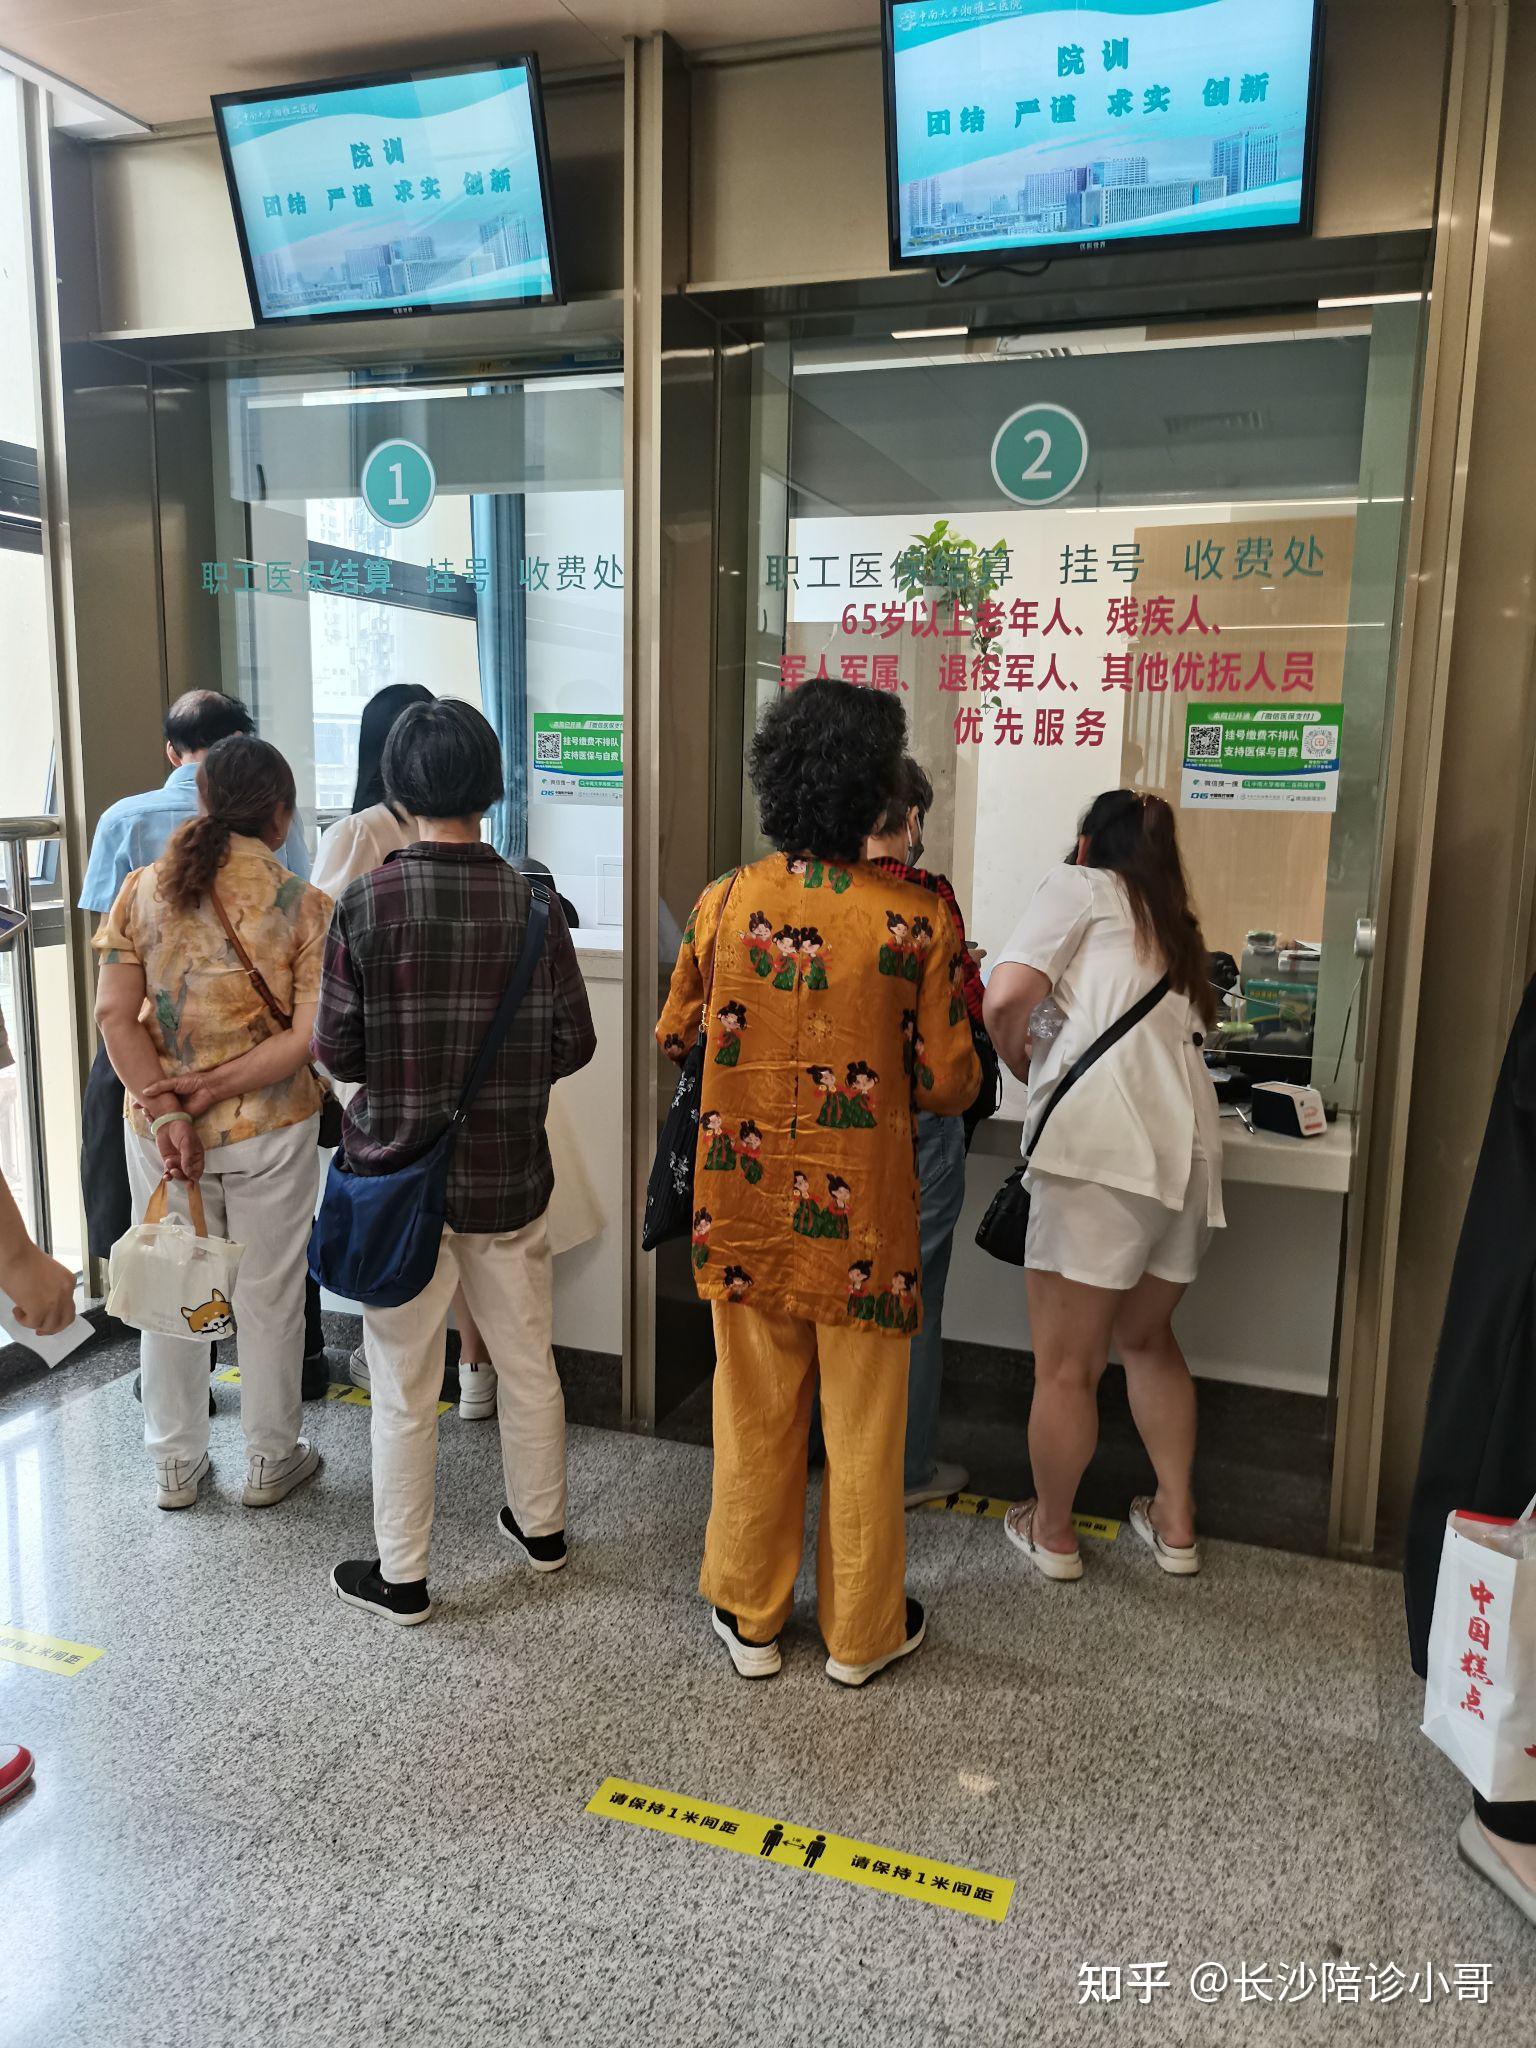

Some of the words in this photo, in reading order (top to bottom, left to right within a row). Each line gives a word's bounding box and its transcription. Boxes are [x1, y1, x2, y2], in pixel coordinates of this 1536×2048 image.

[1056, 37, 1129, 77] 院训
[926, 105, 986, 137] 团结
[1014, 94, 1077, 128] 严谨
[1107, 84, 1172, 117] 求实
[1202, 72, 1270, 106] 创新
[350, 137, 405, 169] 院训
[263, 192, 307, 217] 团结
[327, 184, 373, 211] 严谨
[393, 176, 442, 203] 求实
[463, 167, 512, 196] 创新
[1021, 429, 1052, 480] 2
[388, 462, 409, 506] 1
[201, 557, 394, 595] 职工医保结算
[426, 555, 490, 594] 挂号
[519, 552, 625, 593] 收费处
[766, 545, 1014, 592] 职工医保结算
[1060, 543, 1146, 585] 挂号
[1184, 533, 1325, 580] 收费处
[953, 708, 1108, 747] 优先服务
[1224, 729, 1300, 741] 挂号缴费不排队
[1223, 746, 1299, 758] 支持医保与自费
[1460, 1578, 1495, 1721] 中国糕点
[609, 1791, 740, 1836] 请保持1米间距
[850, 1853, 995, 1904] 请保持1米间距
